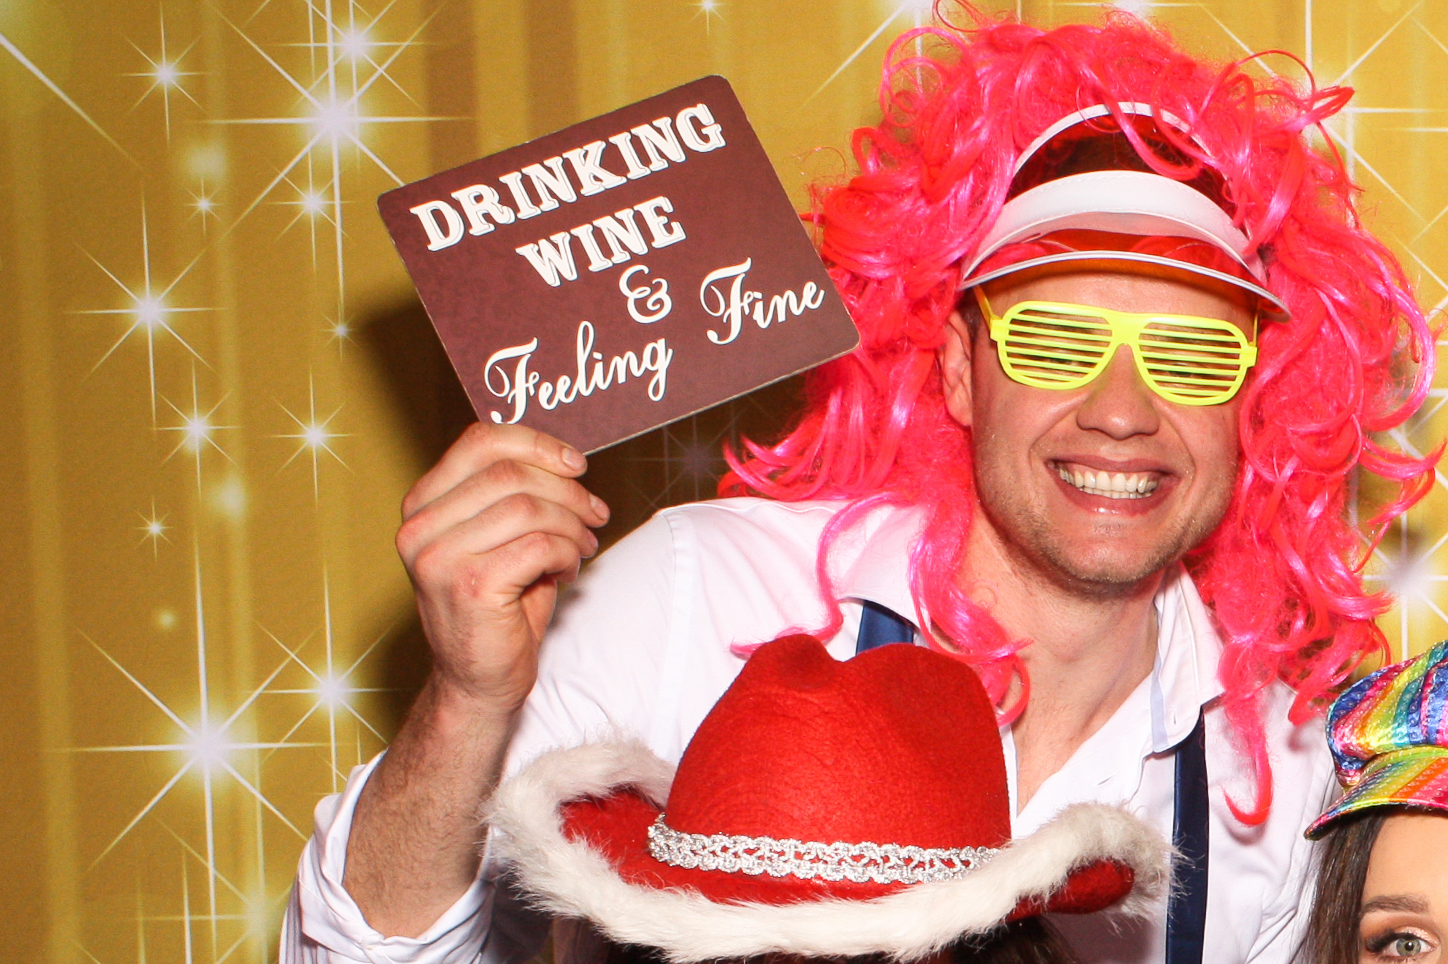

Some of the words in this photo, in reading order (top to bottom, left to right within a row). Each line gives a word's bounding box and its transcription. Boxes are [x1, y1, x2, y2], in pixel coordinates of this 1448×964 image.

[410, 103, 726, 251] DRINKING
[515, 196, 687, 287] WINE
[619, 265, 672, 324] &
[484, 321, 674, 424] Feeling
[699, 257, 825, 345] Fine
